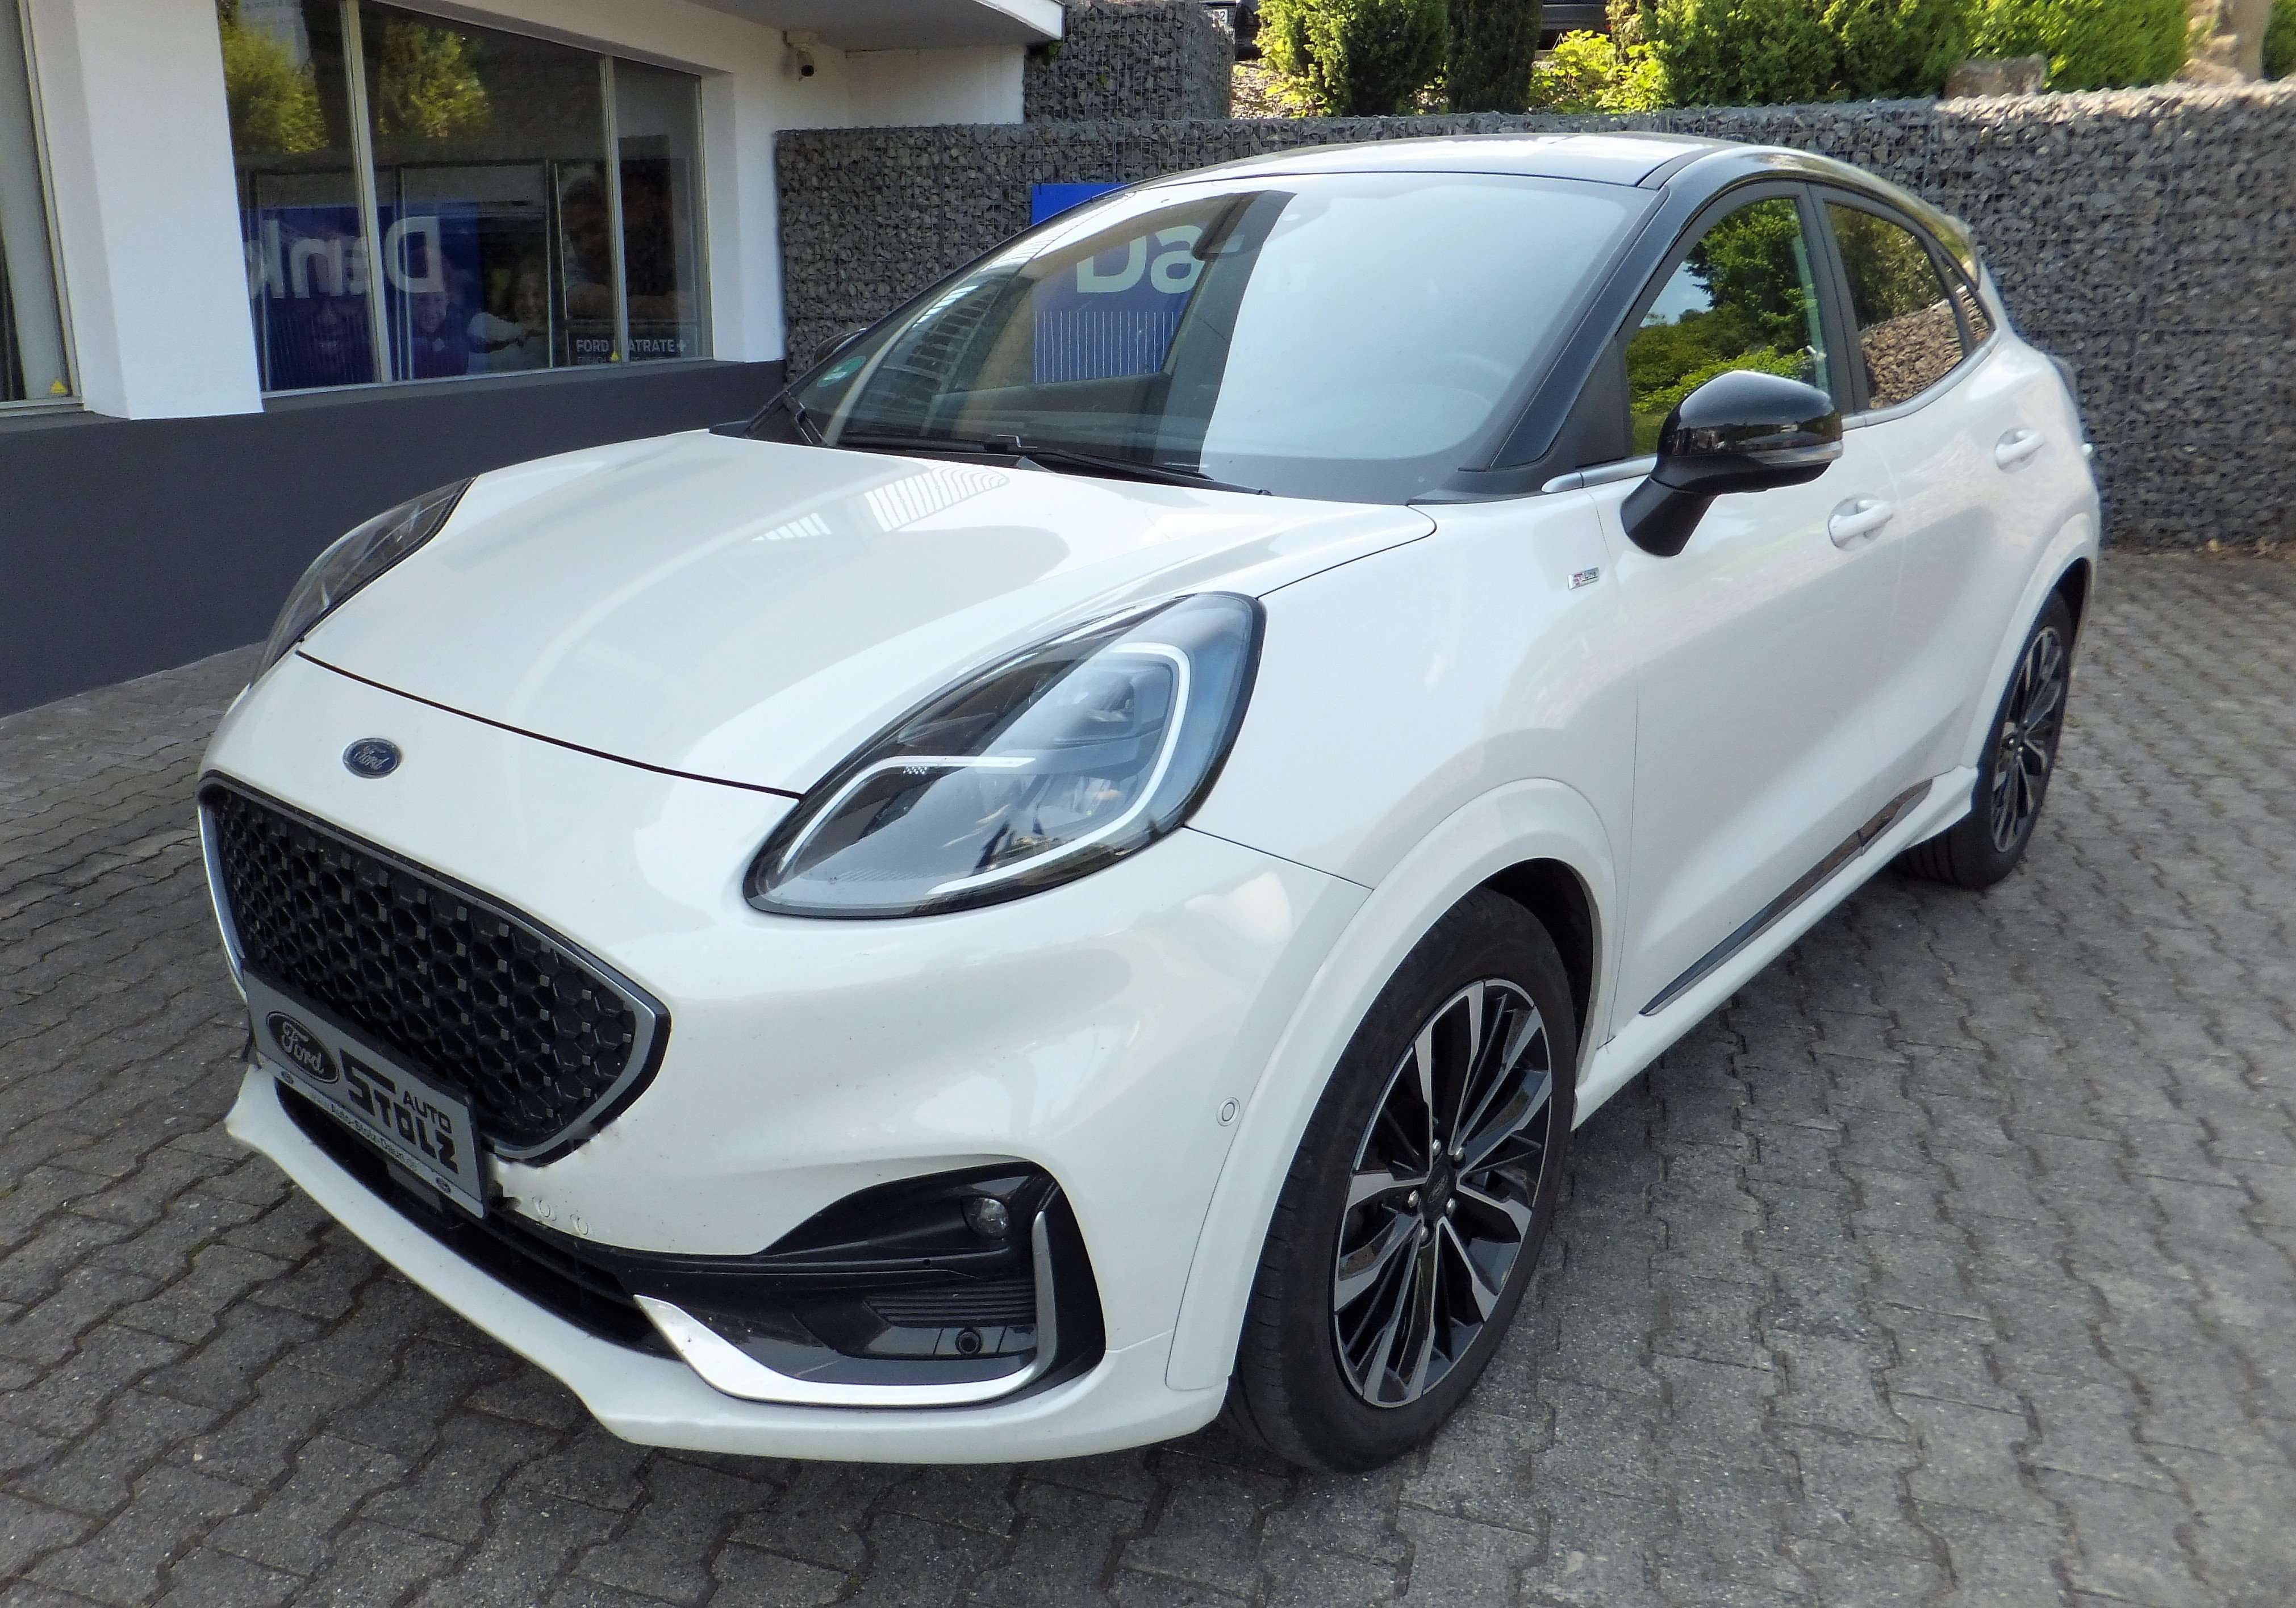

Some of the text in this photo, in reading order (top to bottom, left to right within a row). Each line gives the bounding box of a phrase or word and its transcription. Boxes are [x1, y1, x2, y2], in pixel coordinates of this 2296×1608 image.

[576, 339, 610, 352] FORD
[282, 1021, 453, 1134] Ford AUTO
[340, 1048, 458, 1175] STOLZ
